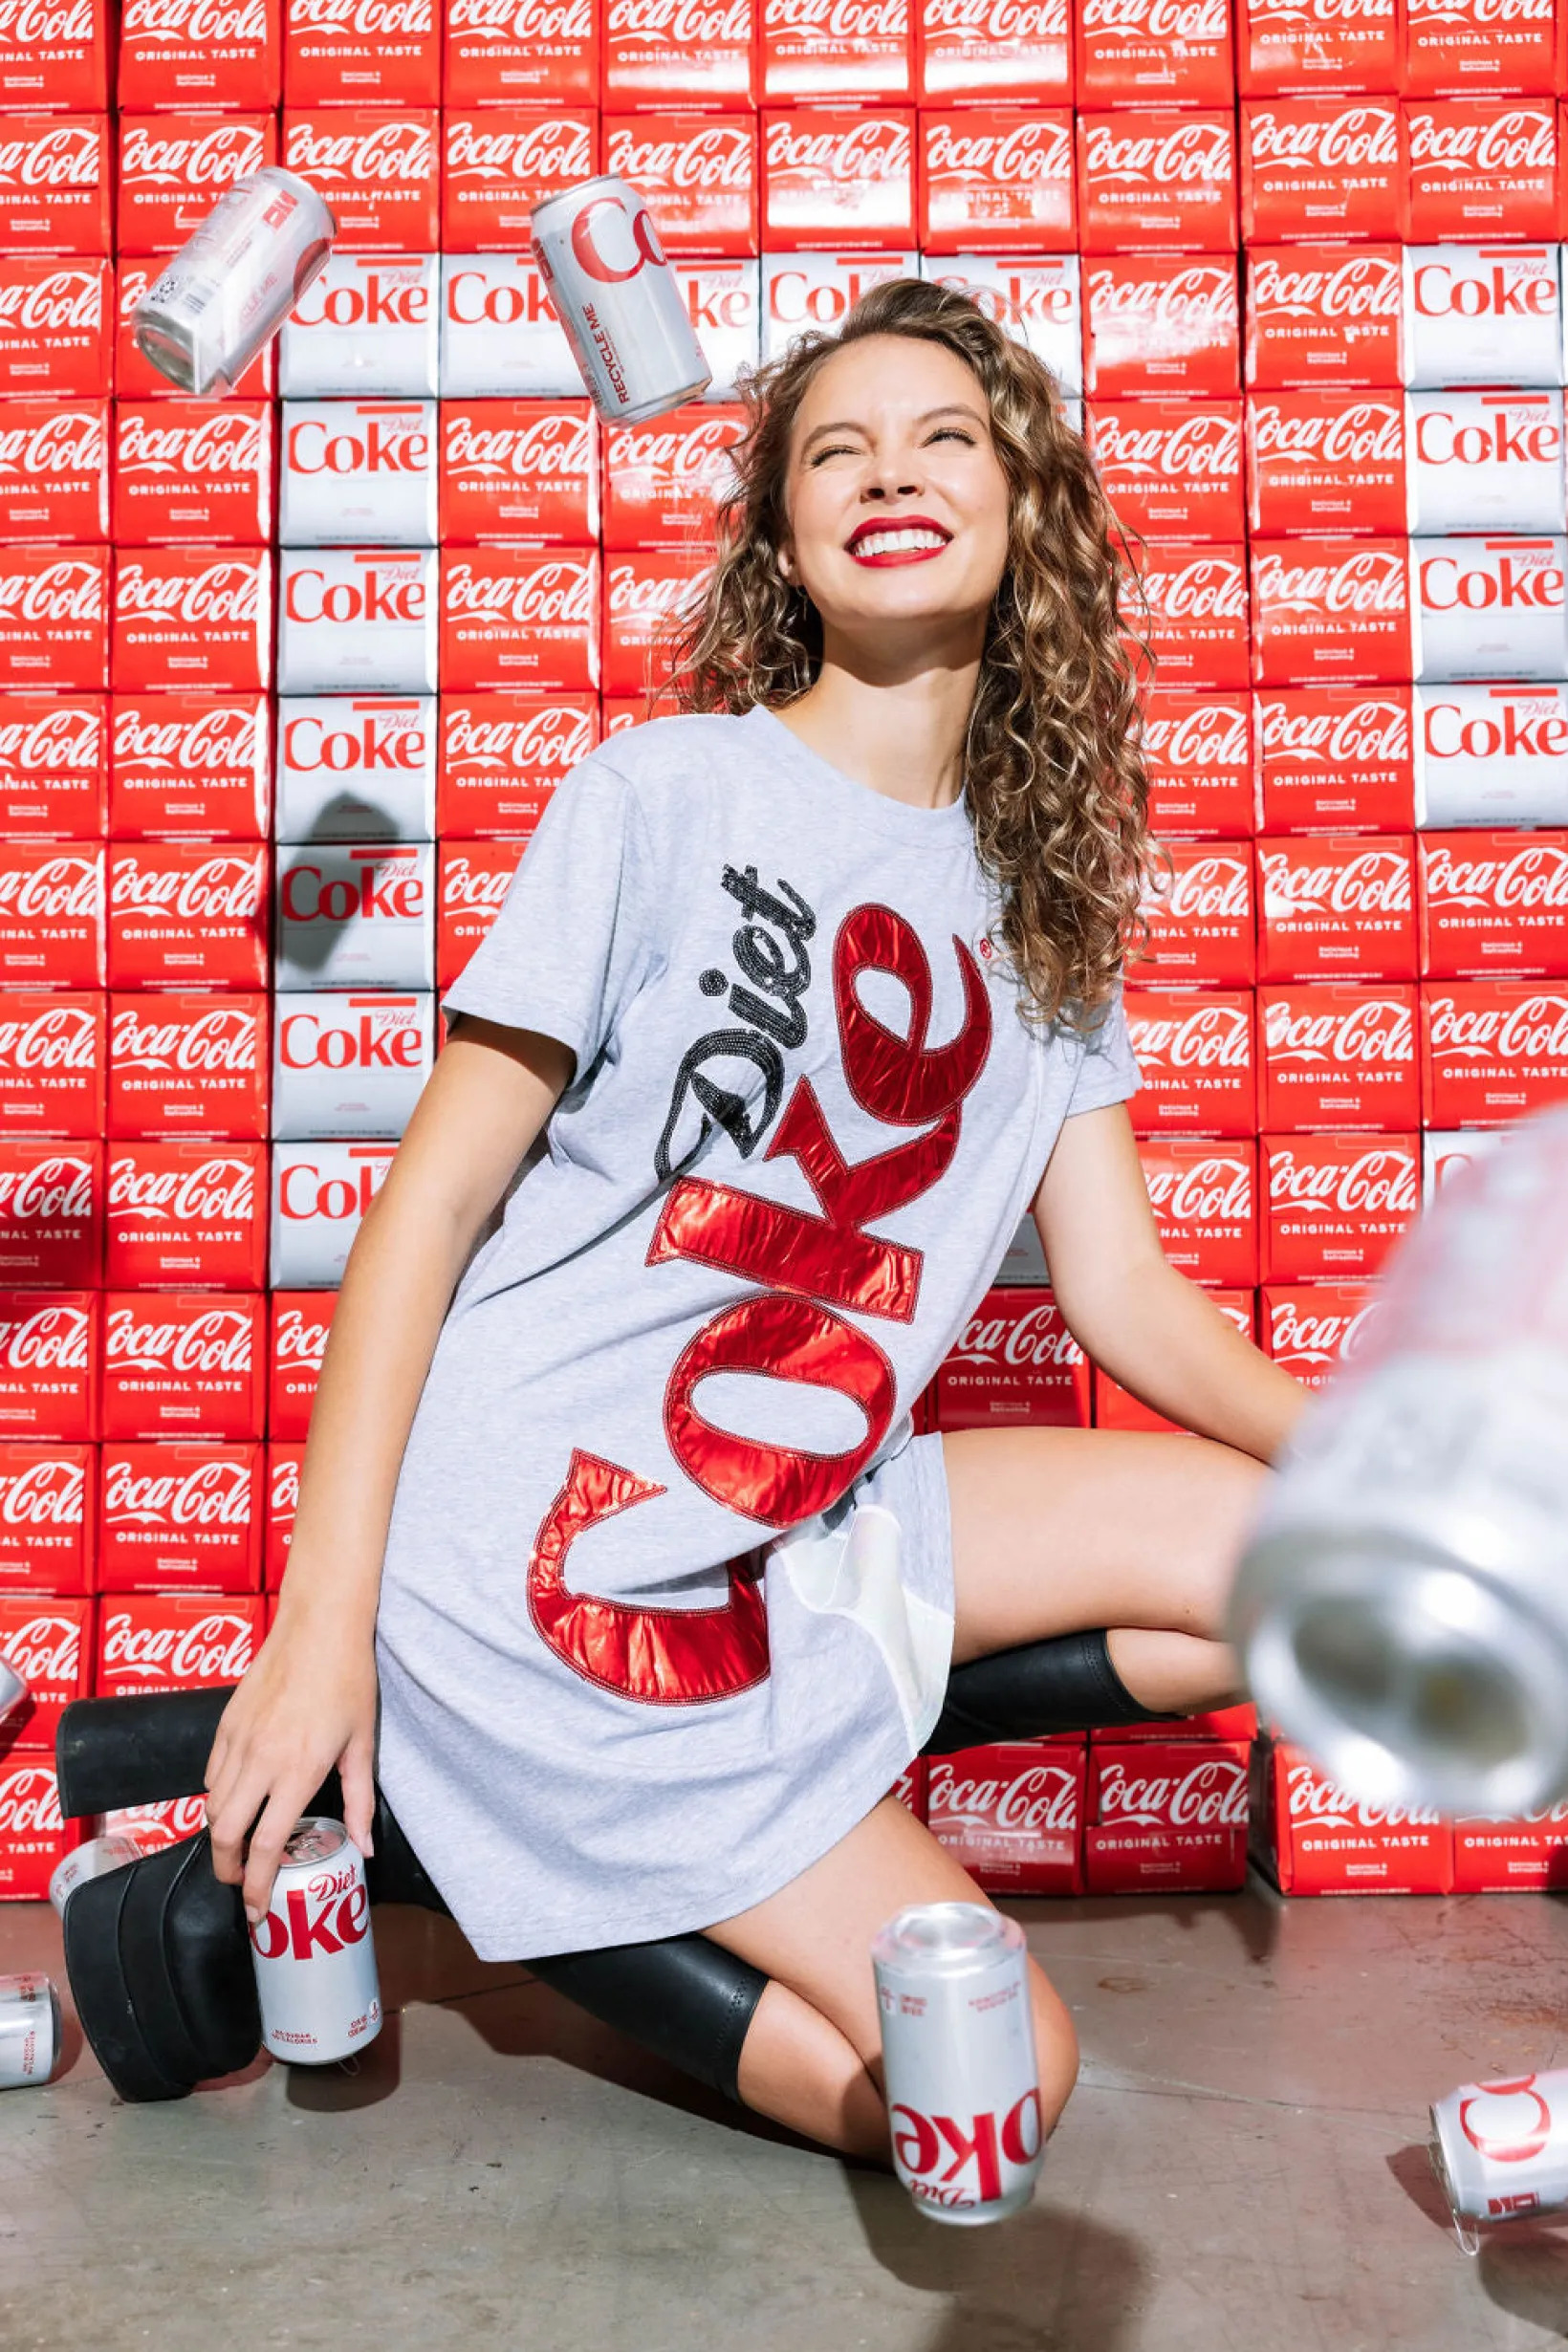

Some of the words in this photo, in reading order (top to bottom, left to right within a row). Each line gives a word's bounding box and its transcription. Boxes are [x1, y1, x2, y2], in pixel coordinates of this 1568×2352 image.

[1260, 31, 1333, 44] ORIGINAL
[1339, 30, 1385, 42] TASTE
[1419, 34, 1492, 47] ORIGINAL
[1497, 33, 1543, 45] TASTE
[38, 49, 85, 61] TASTE
[136, 49, 207, 61] ORIGINAL
[211, 48, 256, 59] TASTE
[299, 45, 371, 58] ORIGINAL
[377, 44, 422, 56] TASTE
[459, 45, 531, 58] ORIGINAL
[536, 44, 581, 56] TASTE
[1095, 47, 1166, 60] ORIGINAL
[1172, 46, 1217, 58] TASTE
[1264, 178, 1337, 191] ORIGINAL
[1342, 177, 1388, 189] TASTE
[1421, 180, 1493, 193] ORIGINAL
[1499, 179, 1545, 191] TASTE
[46, 193, 92, 206] TASTE
[1099, 190, 1170, 204] ORIGINAL
[1176, 189, 1221, 202] TASTE
[1415, 265, 1556, 316] Coke
[447, 272, 558, 324] Cok
[686, 279, 751, 329] ke
[582, 301, 601, 331] ME
[1264, 325, 1337, 338] ORIGINAL
[1342, 324, 1389, 337] TASTE
[44, 336, 91, 348] TASTE
[594, 330, 631, 404] RECYCLE
[1418, 412, 1558, 464] Coke
[290, 422, 430, 473] Coke
[458, 480, 530, 493] ORIGINAL
[535, 479, 580, 491] TASTE
[1270, 474, 1342, 487] ORIGINAL
[1348, 472, 1394, 485] TASTE
[44, 481, 91, 493] TASTE
[128, 483, 200, 496] ORIGINAL
[206, 482, 250, 494] TASTE
[1106, 482, 1178, 495] ORIGINAL
[1184, 481, 1229, 493] TASTE
[379, 564, 420, 581] Diet
[1421, 556, 1564, 610] Coke
[287, 570, 427, 621] Coke
[457, 627, 530, 641] ORIGINAL
[535, 626, 581, 639] TASTE
[1271, 622, 1344, 635] ORIGINAL
[1350, 621, 1398, 633] TASTE
[46, 629, 93, 642] TASTE
[127, 631, 199, 644] ORIGINAL
[205, 630, 250, 642] TASTE
[378, 712, 419, 730] Diet
[1425, 705, 1568, 757] Coke
[286, 718, 426, 770] Coke
[44, 778, 90, 791] TASTE
[124, 777, 196, 791] ORIGINAL
[202, 776, 247, 789] TASTE
[1274, 773, 1346, 786] ORIGINAL
[1352, 772, 1398, 784] TASTE
[376, 861, 417, 879] Diet
[284, 867, 425, 919] Coke
[1276, 921, 1350, 933] ORIGINAL
[1356, 919, 1404, 931] TASTE
[1440, 916, 1513, 928] ORIGINAL
[1518, 914, 1564, 926] TASTE
[41, 927, 88, 940] TASTE
[122, 927, 195, 940] ORIGINAL
[201, 926, 247, 938] TASTE
[374, 1011, 415, 1028] Diet
[654, 862, 817, 1184] Diet
[282, 1016, 423, 1068] Coke
[40, 1077, 87, 1089] TASTE
[122, 1078, 195, 1091] ORIGINAL
[201, 1077, 247, 1089] TASTE
[1277, 1072, 1351, 1084] ORIGINAL
[1357, 1070, 1405, 1082] TASTE
[279, 1165, 380, 1220] Cok
[35, 1229, 81, 1241] TASTE
[1280, 1223, 1354, 1235] ORIGINAL
[1360, 1221, 1407, 1233] TASTE
[119, 1231, 191, 1244] ORIGINAL
[197, 1230, 243, 1242] TASTE
[526, 902, 993, 1709] Coke
[119, 1381, 191, 1393] ORIGINAL
[197, 1379, 243, 1391] TASTE
[948, 1375, 1021, 1387] ORIGINAL
[1027, 1373, 1073, 1385] TASTE
[33, 1383, 78, 1395] TASTE
[27, 1535, 74, 1548] TASTE
[117, 1532, 188, 1545] ORIGINAL
[194, 1531, 239, 1543] TASTE
[8, 1841, 55, 1855] TASTE
[1097, 1837, 1170, 1849] ORIGINAL
[1176, 1835, 1224, 1847] TASTE
[1303, 1838, 1377, 1850] ORIGINAL
[1383, 1836, 1430, 1848] TASTE
[308, 1863, 356, 1903] Diet
[249, 1884, 369, 1961] oke
[891, 2087, 1042, 2203] oke
[909, 2177, 977, 2210] Diet
